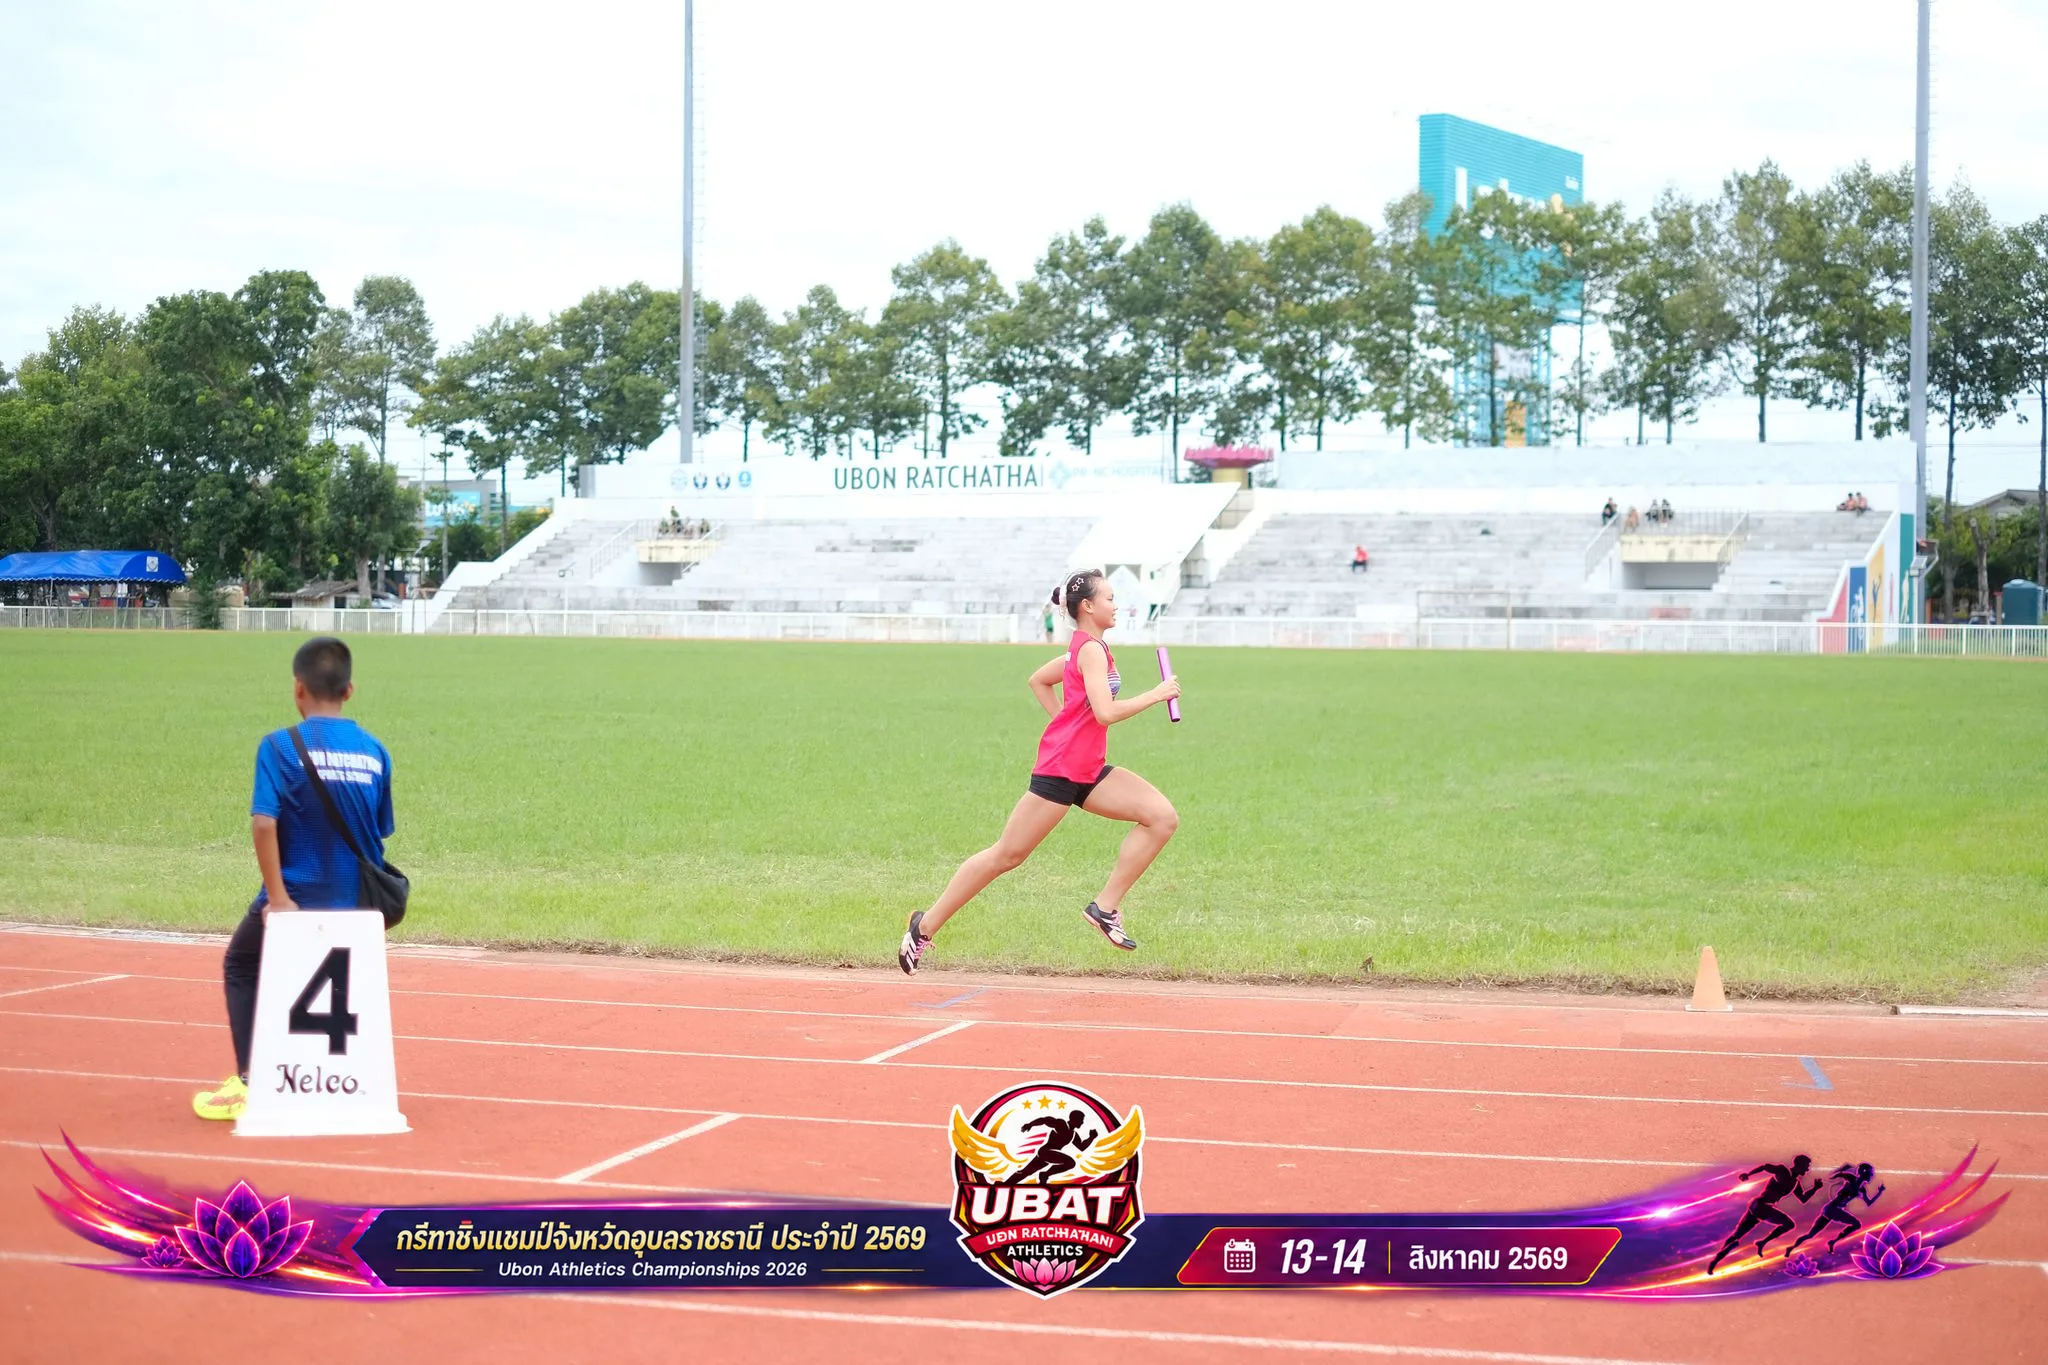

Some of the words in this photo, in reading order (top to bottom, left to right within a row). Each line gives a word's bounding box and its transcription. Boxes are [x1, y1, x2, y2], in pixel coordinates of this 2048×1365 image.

[834, 466, 897, 489] UBON
[906, 464, 1043, 488] RATCHATHA
[288, 946, 359, 1056] 4
[275, 1063, 359, 1095] Nelco
